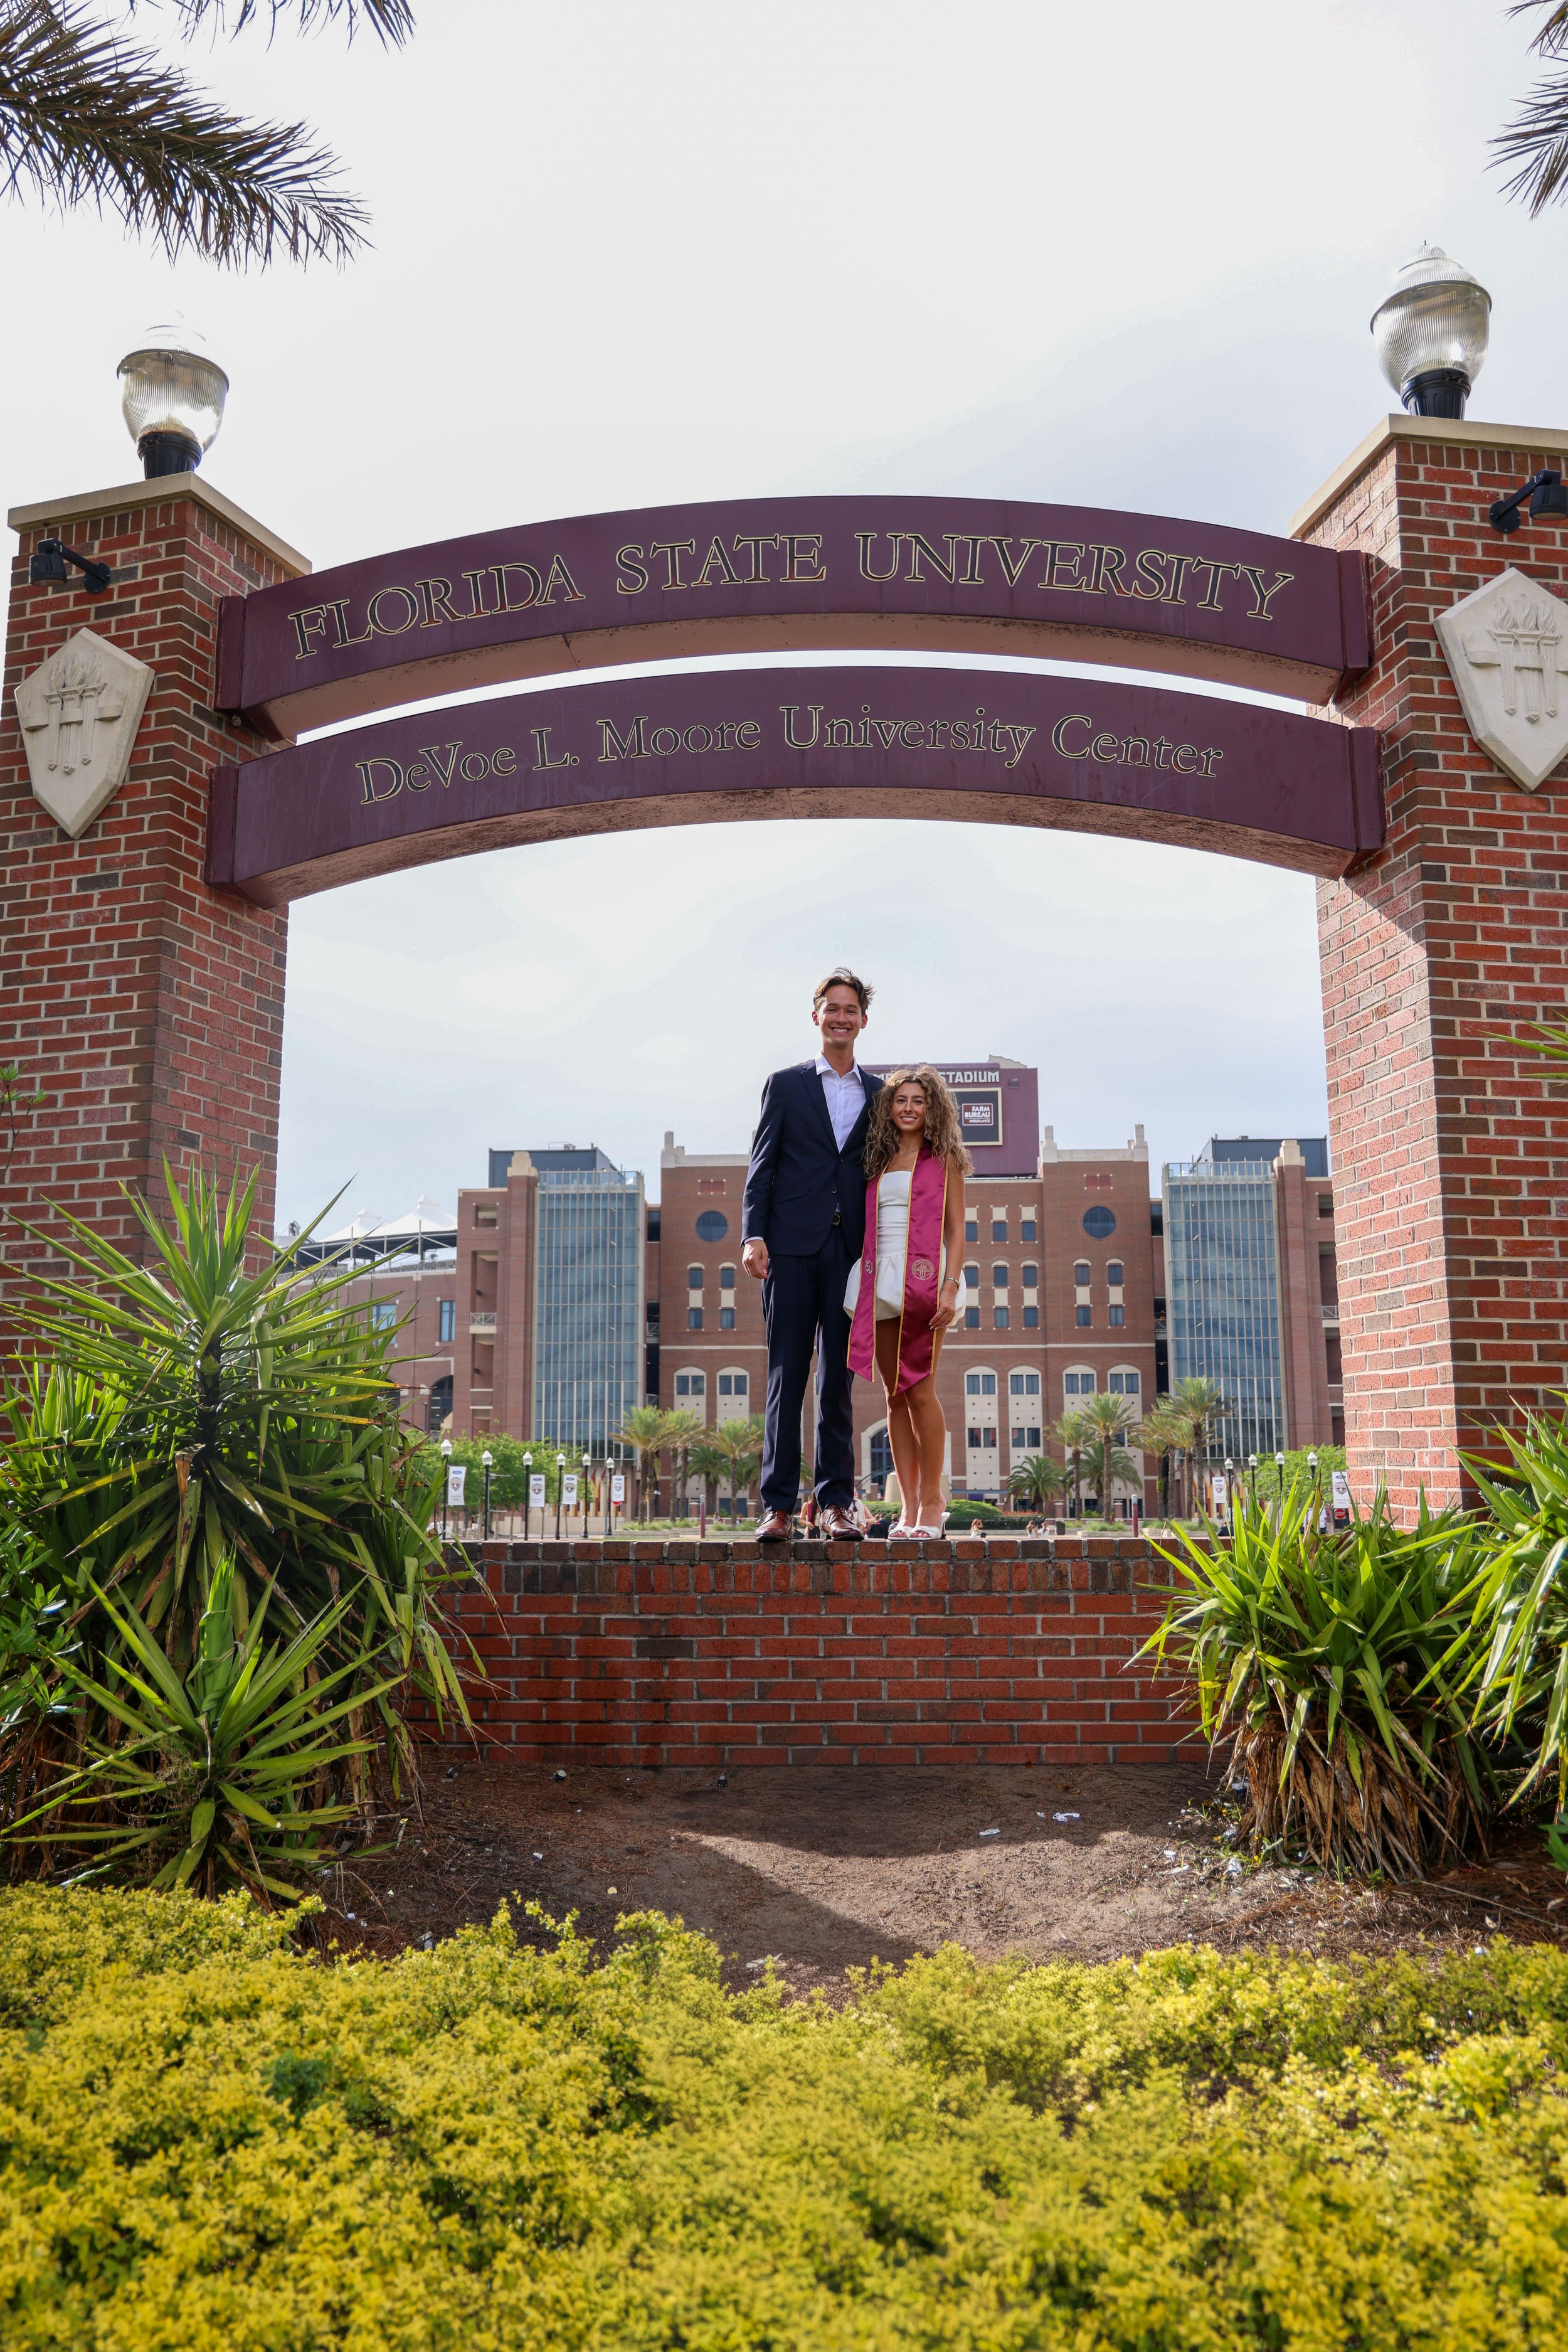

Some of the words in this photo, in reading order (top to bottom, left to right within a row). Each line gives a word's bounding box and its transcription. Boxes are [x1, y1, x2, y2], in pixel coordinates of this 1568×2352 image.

[288, 554, 585, 660] FLORIDA
[616, 533, 827, 594] STATE
[854, 532, 1294, 620] UNIVERSITY
[355, 742, 517, 806] DeVoe
[530, 728, 580, 771] L.
[596, 716, 761, 762] Moore
[779, 705, 1036, 769] University
[1052, 714, 1224, 779] Center
[938, 1071, 1000, 1083] STADIUM
